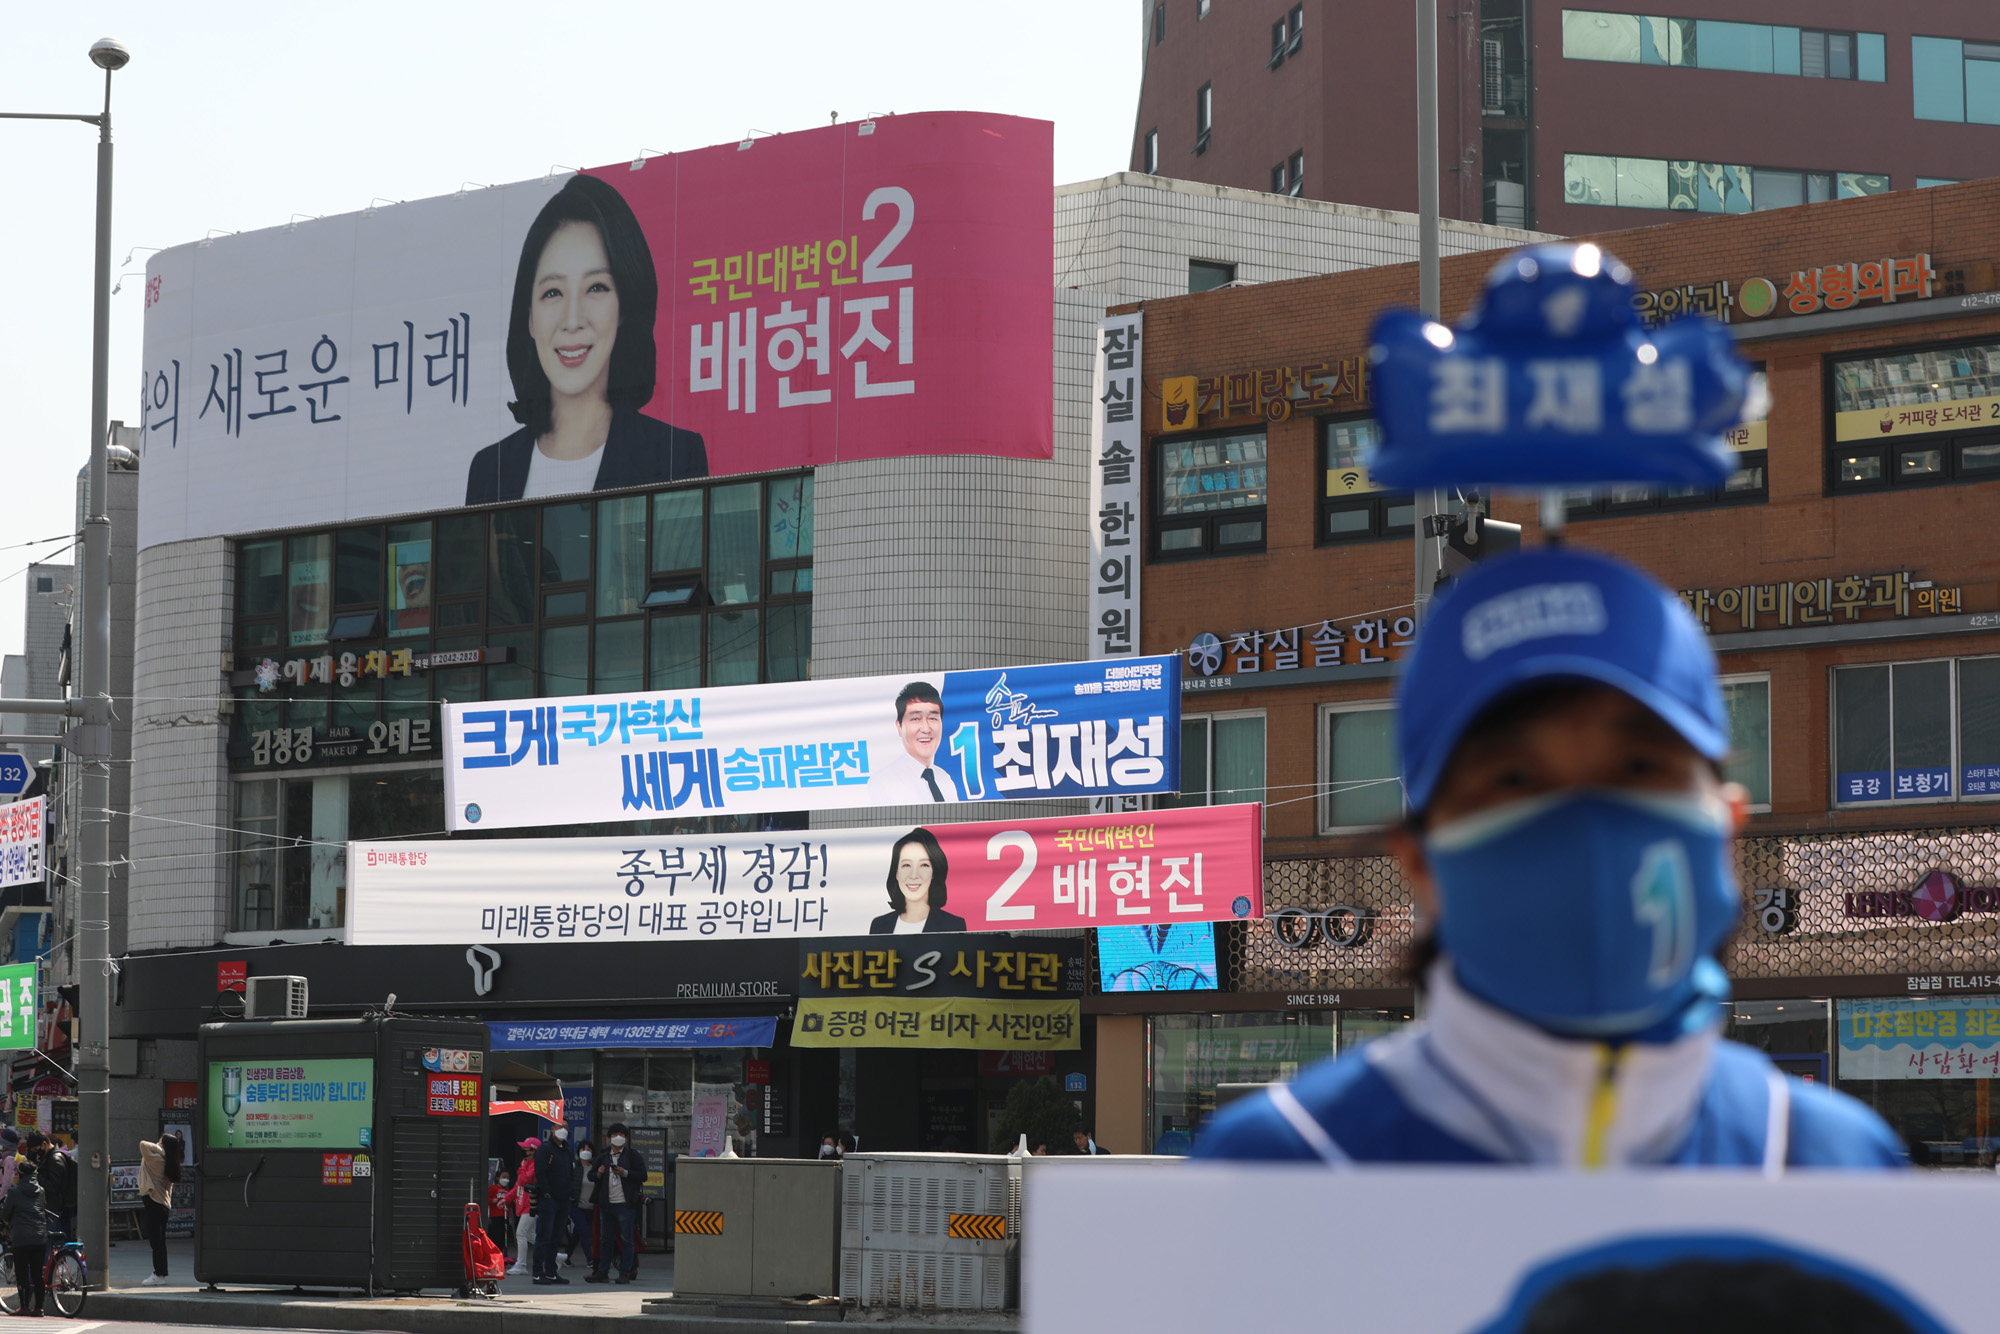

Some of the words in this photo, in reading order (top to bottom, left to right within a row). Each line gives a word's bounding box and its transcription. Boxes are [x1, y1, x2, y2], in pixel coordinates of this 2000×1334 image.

[862, 186, 914, 283] 2
[689, 235, 857, 304] 국민대변인
[1783, 253, 1936, 315] 성형외과
[690, 286, 915, 414] 배현진
[199, 334, 349, 438] 새로운
[372, 312, 470, 415] 미래
[1198, 366, 1296, 422] 커피랑
[1295, 357, 1373, 409] 도서
[1898, 410, 1938, 427] 커피랑
[1942, 404, 1982, 423] 도서관
[1917, 588, 1961, 614] 의원
[432, 651, 478, 664] T.2042-2828
[1105, 664, 1162, 679] 더불어민주당
[1074, 682, 1102, 695] 송파을
[1103, 679, 1141, 693] 국회의원
[1142, 678, 1162, 690] 후보
[252, 726, 314, 766] 김청경
[329, 727, 350, 738] HAIR
[367, 719, 432, 754] 오테르
[462, 705, 559, 769] 크게
[562, 697, 703, 746] 국가혁신
[321, 746, 344, 758] MAKE
[346, 745, 358, 756] UP
[723, 740, 870, 792] 송파발전
[950, 721, 985, 800] 1
[991, 716, 1164, 790] 최재성
[1850, 778, 1881, 795] 금강
[1897, 772, 1949, 793] 보청기
[1967, 768, 1986, 779] 스타키
[1967, 781, 1986, 792] 오티콘
[1053, 823, 1155, 853] 국민대변인
[378, 852, 428, 866] 미래통합당
[616, 845, 729, 898] 종부세
[742, 841, 828, 896] 경감!
[985, 830, 1038, 922] 2
[1052, 852, 1204, 917] 배현진
[481, 902, 630, 940] 미래통합당의
[637, 902, 689, 935] 대표
[696, 897, 828, 937] 공약입니다
[1754, 888, 1787, 933] 경
[801, 949, 902, 989] 사진관
[949, 950, 1063, 991] 사진관
[1907, 976, 1942, 990] 잠실점
[677, 983, 736, 998] PREMIUM
[738, 981, 778, 996] STORE
[1287, 994, 1315, 1005] SINCE
[1317, 994, 1340, 1005] 1984
[506, 1027, 535, 1041] 갤럭시
[536, 1026, 557, 1040] S20
[559, 1027, 588, 1040] 역대급
[588, 1026, 611, 1039] 혜택
[667, 1024, 689, 1038] 할인
[827, 1010, 867, 1038] 증명
[874, 1012, 921, 1039] 여권
[930, 1012, 979, 1039] 비자
[986, 1013, 1074, 1041] 사진인화
[1852, 1009, 1957, 1038] 다초점안경
[246, 1067, 274, 1080] 민생경제
[246, 1082, 289, 1102] 숨통부터
[328, 1081, 366, 1102] 합니다!
[695, 1115, 721, 1129] 봄맞이
[695, 1130, 712, 1144] 시즌
[354, 1166, 370, 1176] 54-2
